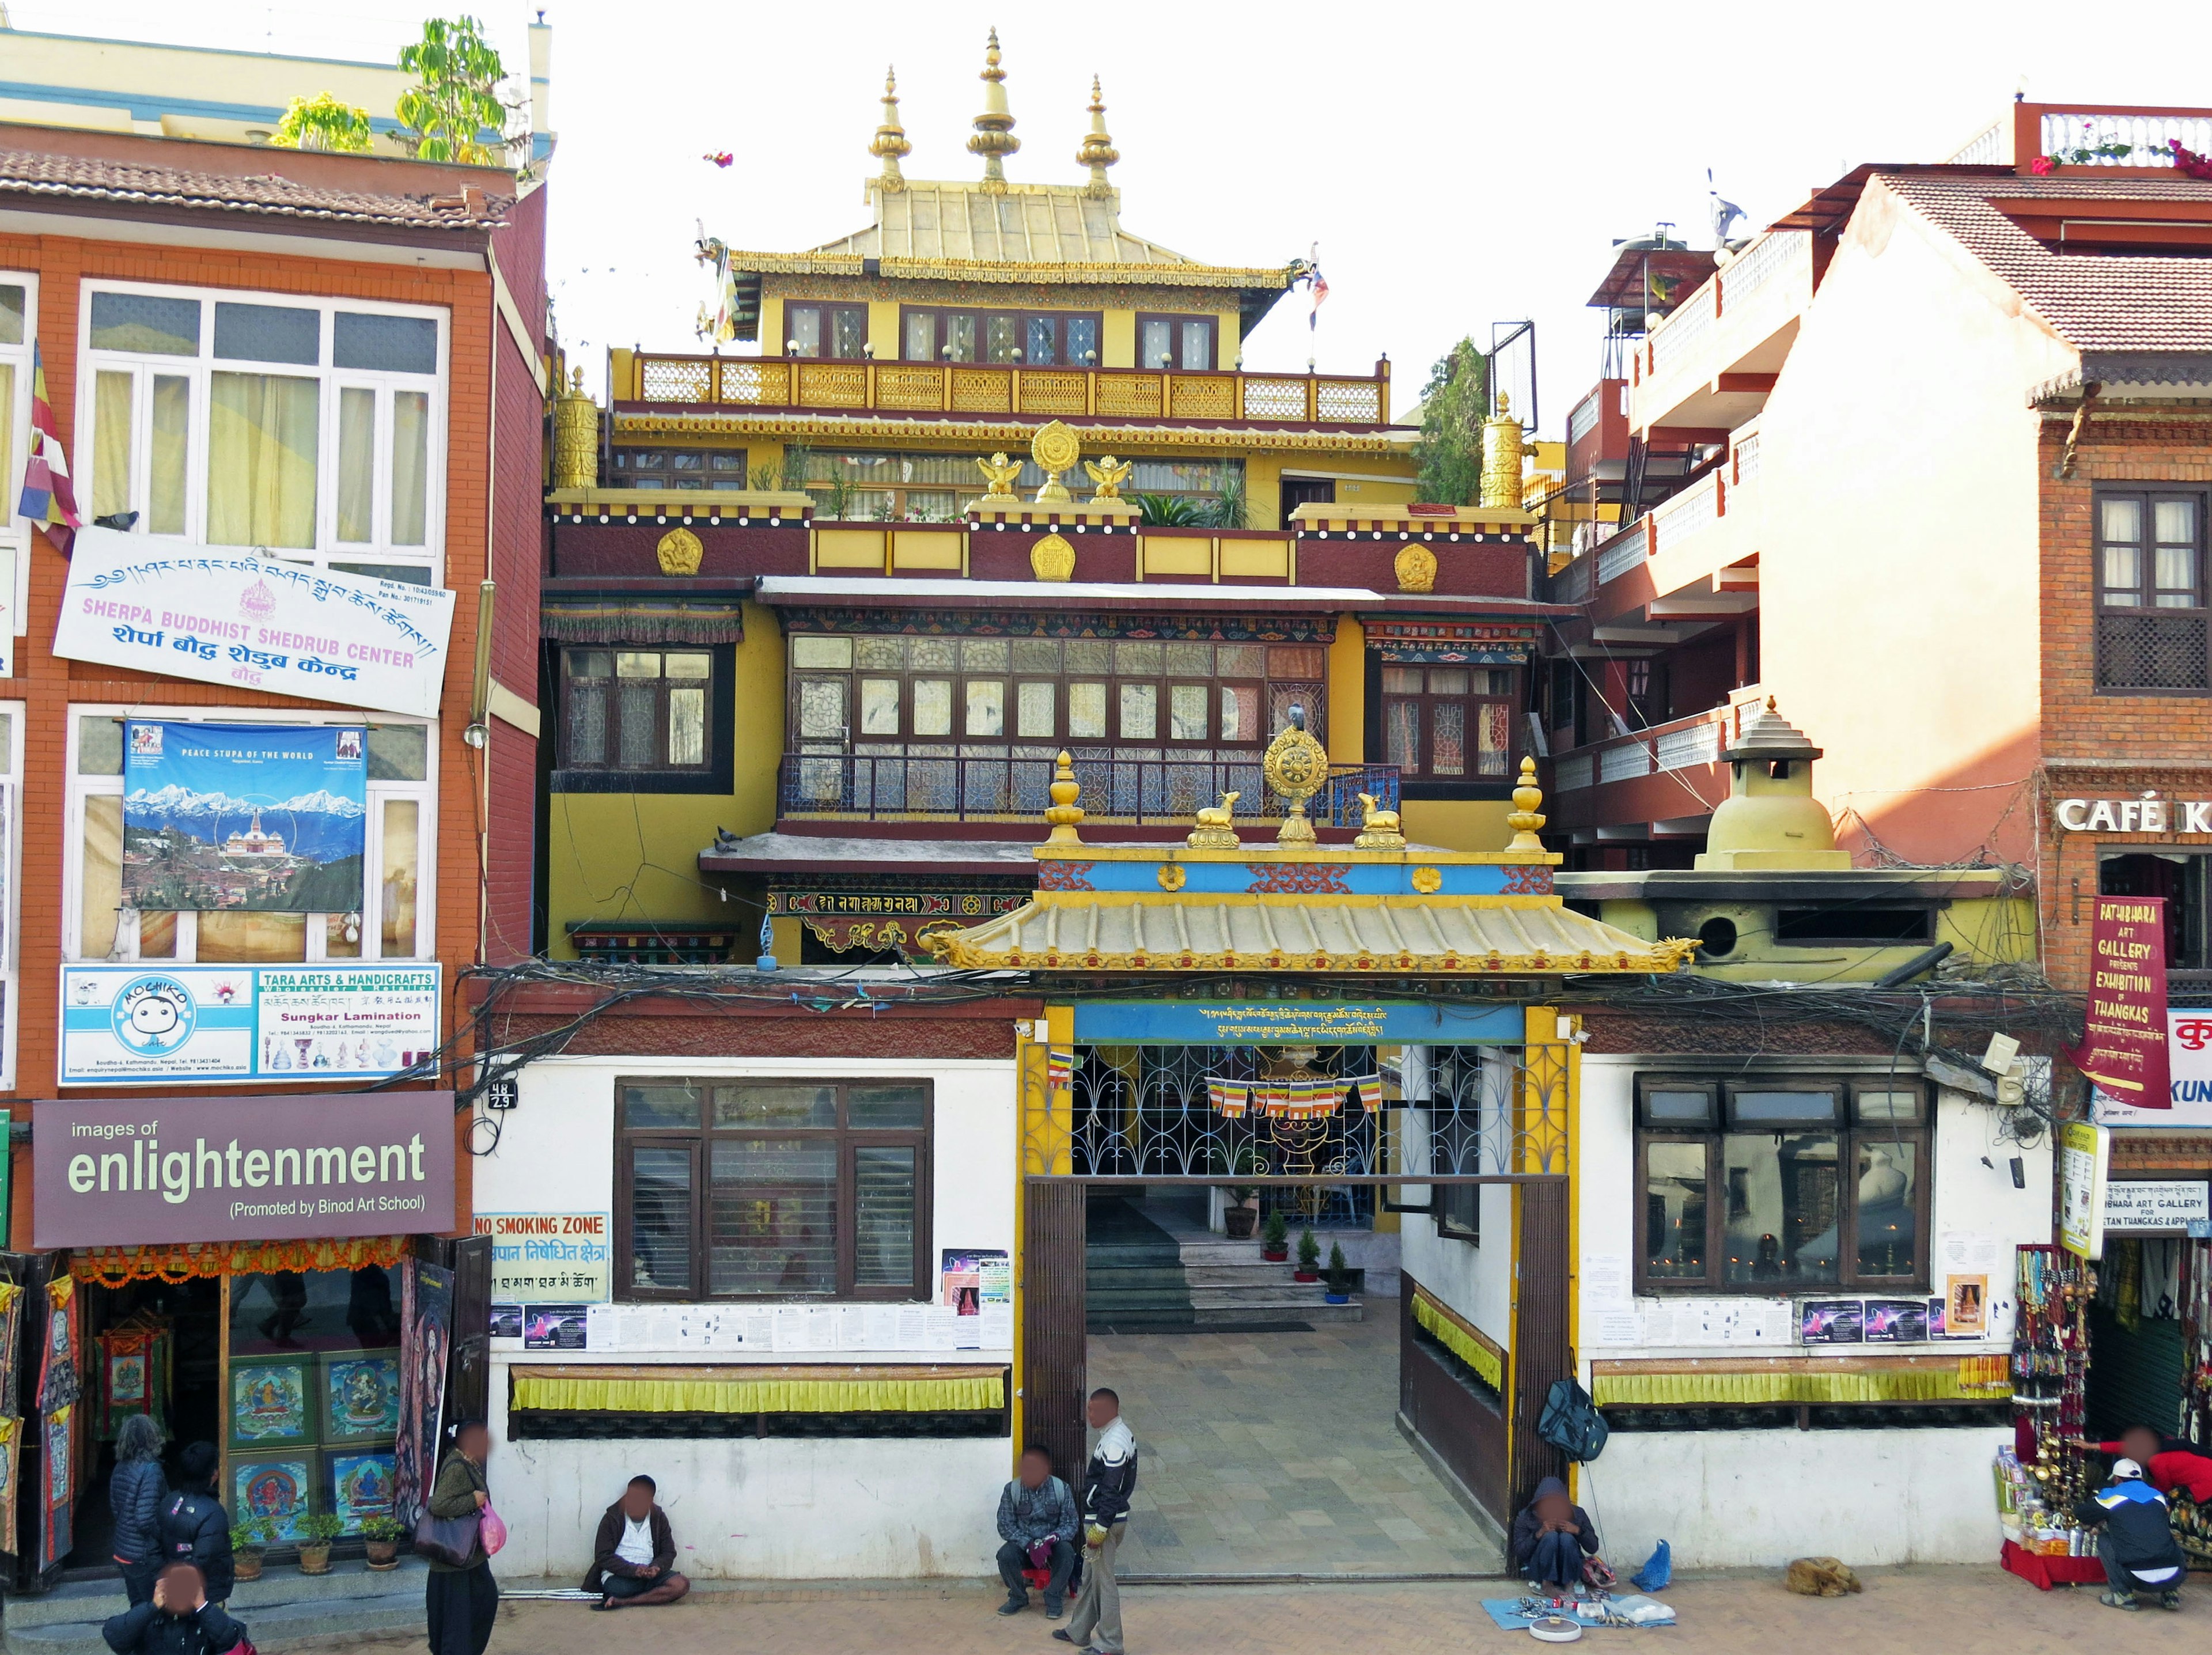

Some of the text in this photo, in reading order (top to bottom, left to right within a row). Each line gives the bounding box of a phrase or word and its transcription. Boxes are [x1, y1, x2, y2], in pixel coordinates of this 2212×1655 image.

[380, 580, 396, 590] Regd.
[403, 595, 433, 606] 301719151
[82, 597, 414, 669] SHERPA BUDDHIST SHEDRUB CENTER
[112, 624, 165, 647] शेर्पा
[228, 644, 290, 670] शेडुब
[297, 656, 360, 681] केन्द्र
[181, 748, 210, 757] PEACE
[214, 749, 243, 758] STUPA
[262, 751, 278, 759] THE
[282, 751, 313, 760] WORLD
[2100, 903, 2156, 924] PATHIBHARA
[2118, 927, 2134, 938] ART
[2098, 939, 2151, 960] GALLERY
[2109, 959, 2138, 971] PRESENTS
[264, 974, 432, 985] TARA ARTS & HANDICRAFTS
[2096, 971, 2151, 993] EXHIBITION
[124, 982, 187, 1005] MOCHIKO
[2118, 993, 2124, 1001] OF
[281, 1012, 421, 1023] Sungkar Lamination
[2094, 999, 2149, 1024] THANGKAS
[493, 1083, 508, 1094] 48
[491, 1096, 509, 1108] 29
[72, 1120, 158, 1139] images of
[68, 1133, 426, 1204] enlightenment
[230, 1194, 426, 1220] (Promoted by Binod Art School)
[2105, 1199, 2202, 1208] IBHARA ART GALLERY
[475, 1216, 604, 1234] NO SMOKING ZONE
[2124, 1217, 2163, 1226] THANGKAS
[2165, 1217, 2170, 1226] &
[524, 1239, 578, 1262] निषेधित
[580, 1239, 607, 1264] क्षेत्र
